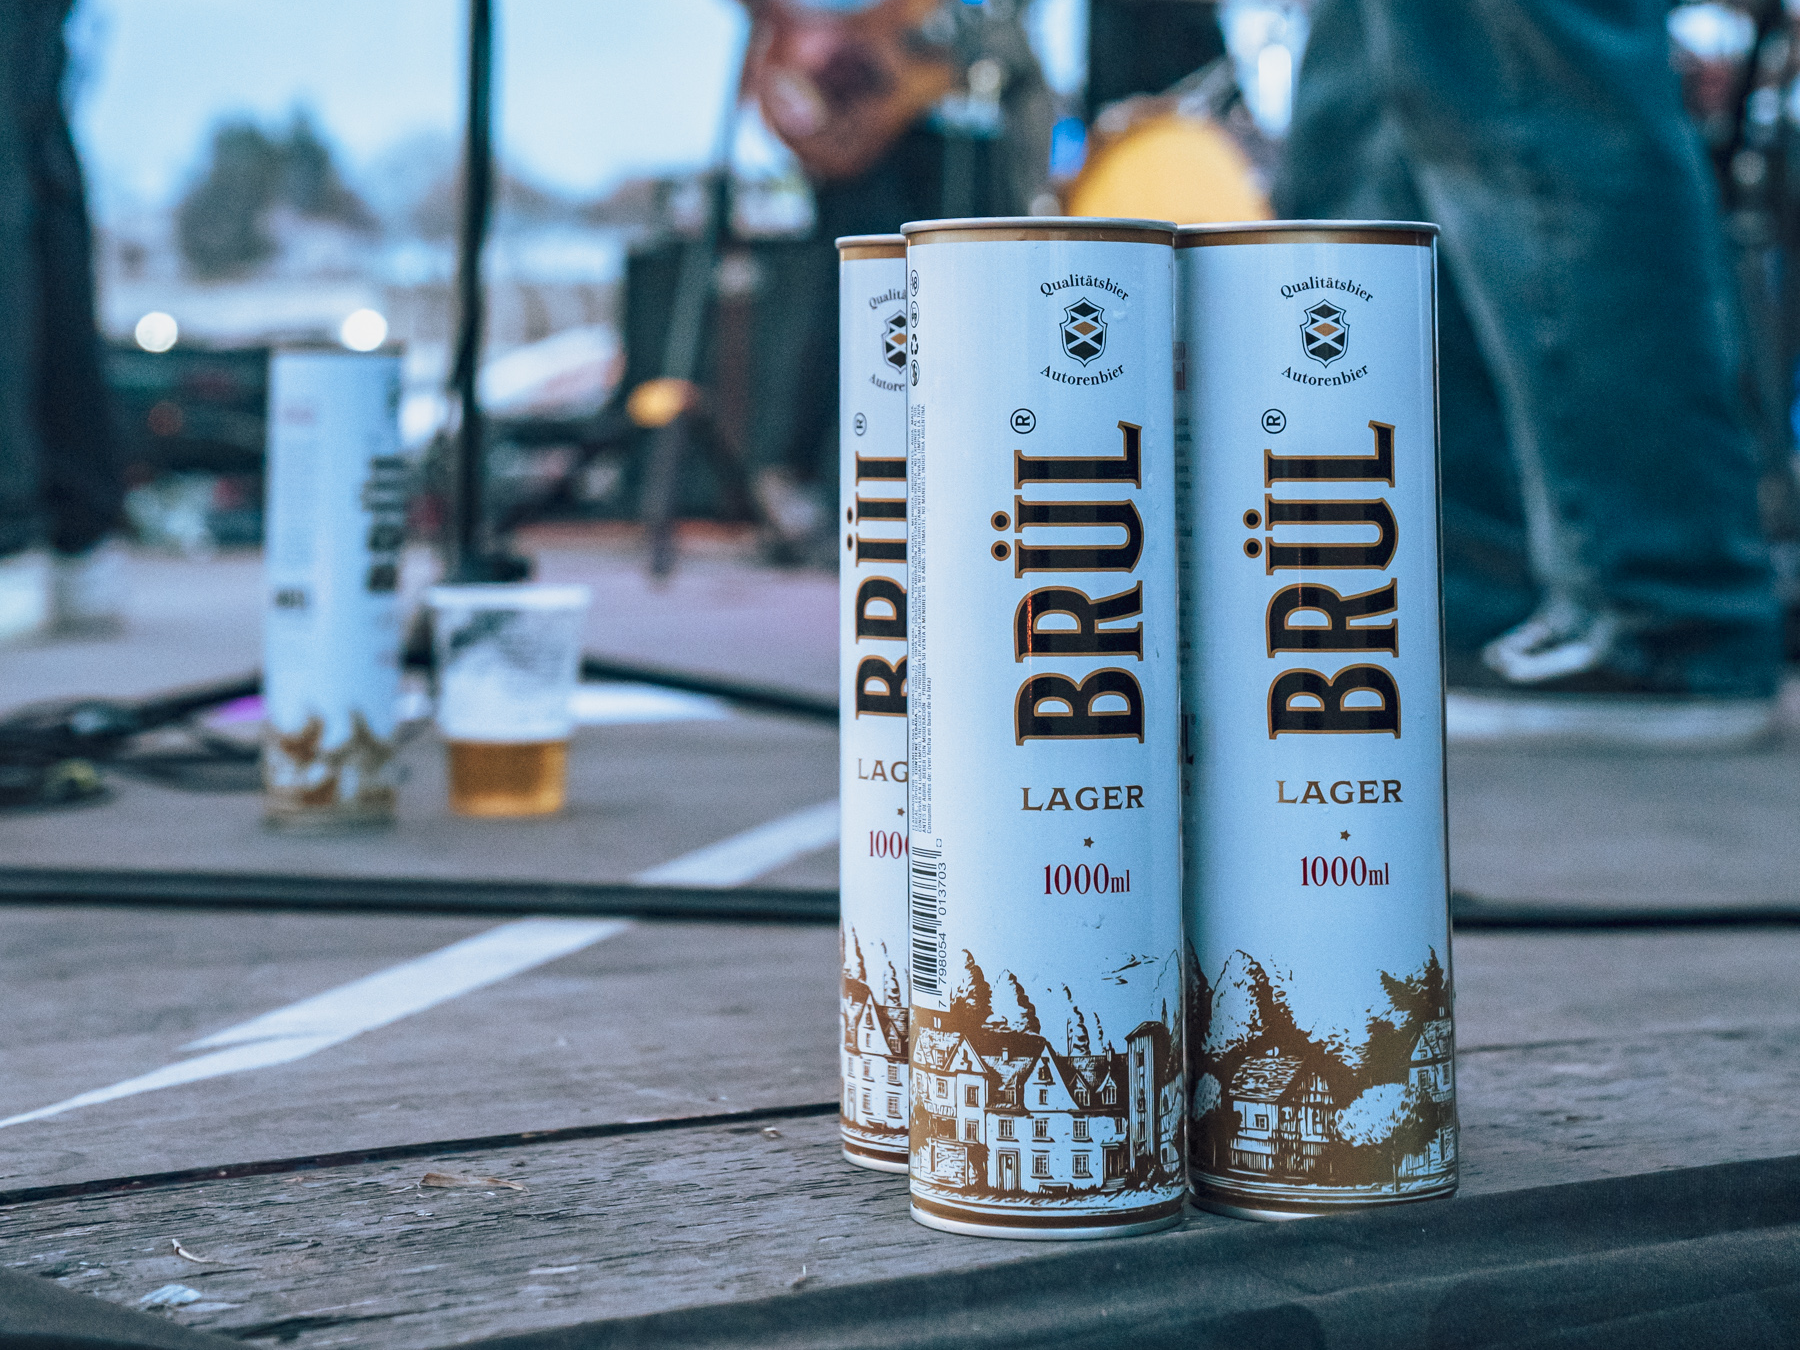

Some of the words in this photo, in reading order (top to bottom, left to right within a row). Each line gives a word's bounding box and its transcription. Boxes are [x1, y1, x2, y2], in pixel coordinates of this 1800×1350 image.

[1040, 274, 1129, 301] Qualitätsbier
[1280, 276, 1374, 303] Qualitätsbier
[1040, 364, 1125, 386] Autorenbier
[1281, 364, 1369, 387] Autorenbier
[921, 506, 926, 514] NO
[991, 420, 1145, 746] BRÜL
[1243, 420, 1402, 741] BRÜL
[926, 728, 931, 736] en
[1020, 785, 1145, 811] LAGER
[1277, 779, 1404, 805] LAGER
[869, 830, 908, 860] 100
[1043, 863, 1131, 896] 1000ml
[1300, 855, 1391, 888] 1000ml
[938, 862, 947, 916] 013703
[938, 932, 947, 985] 798054
